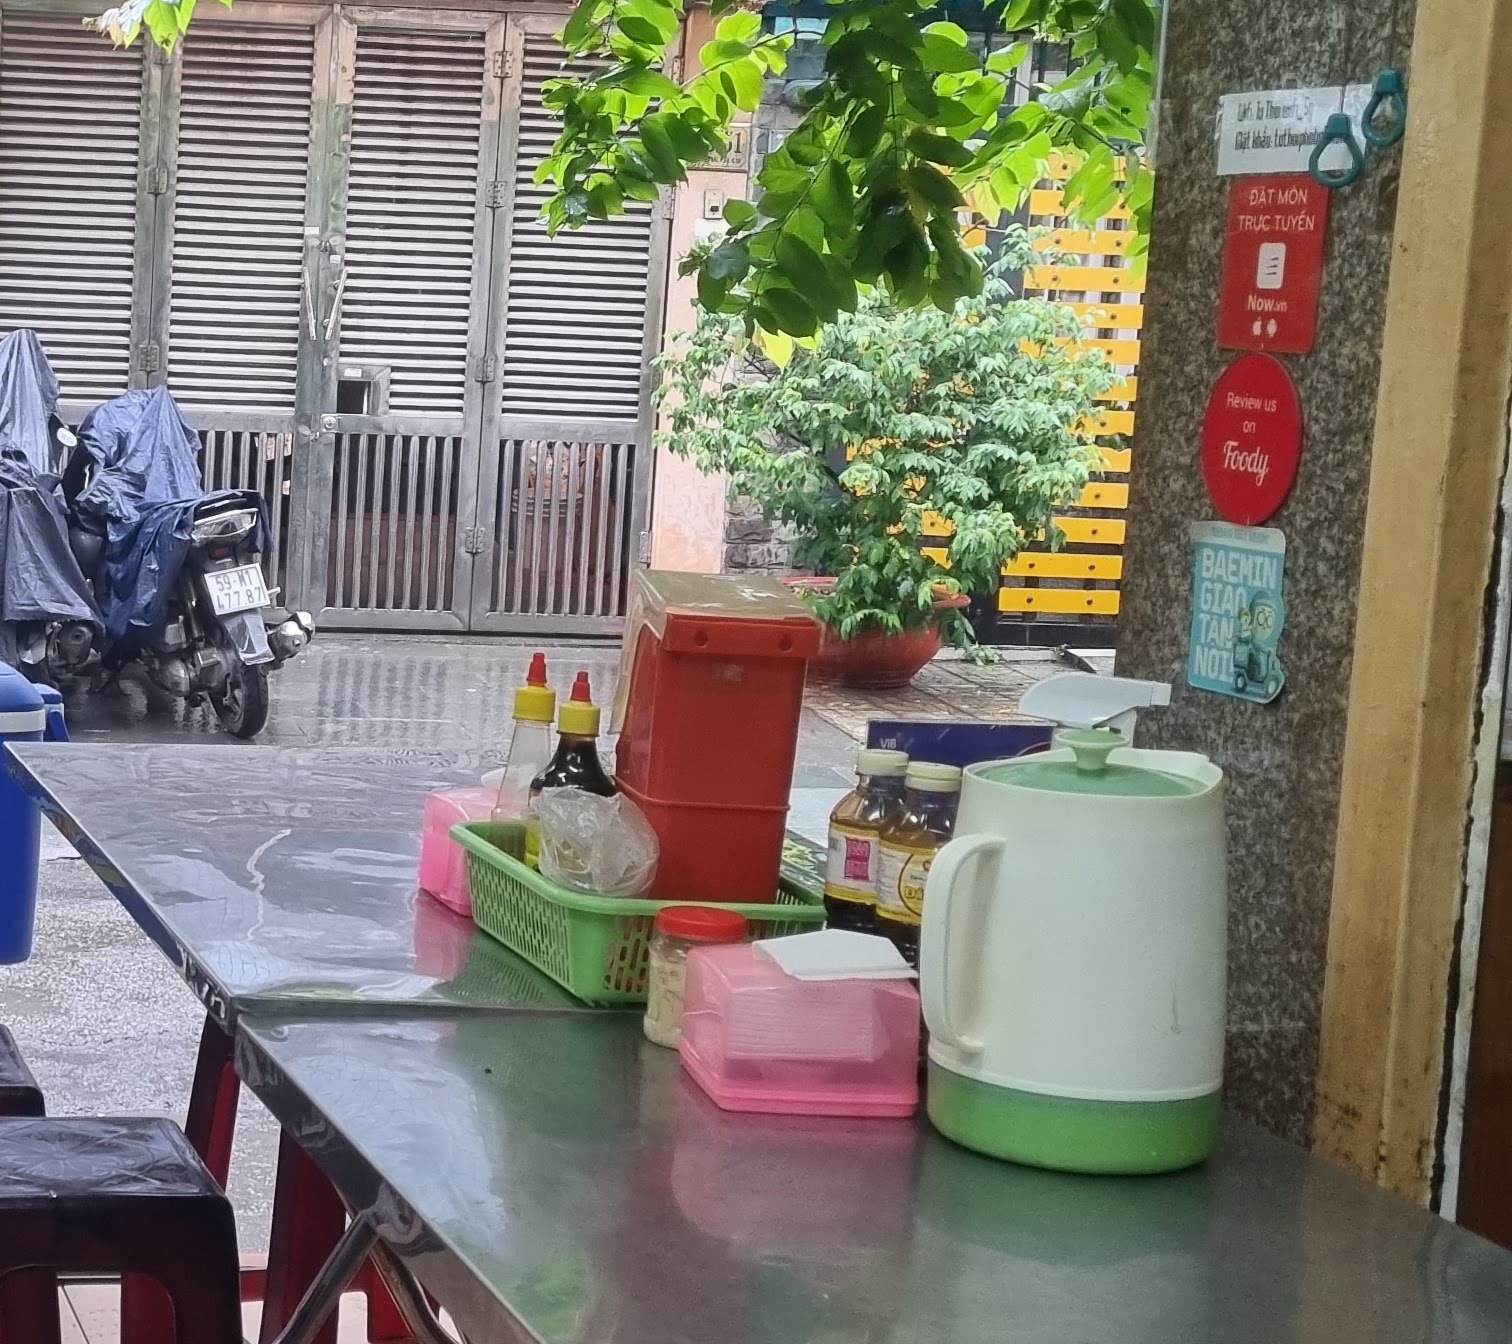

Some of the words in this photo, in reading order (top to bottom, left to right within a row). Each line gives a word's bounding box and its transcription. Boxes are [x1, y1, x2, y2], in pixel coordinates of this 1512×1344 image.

[1249, 185, 1275, 209] ĐẶT
[1239, 214, 1271, 235] TRỰC
[1275, 208, 1316, 232] TUYẾN
[1247, 294, 1288, 313] Now.vn
[1226, 391, 1262, 412] Review
[1264, 399, 1278, 413] us
[1243, 420, 1256, 434] on
[1223, 440, 1270, 487] Foody
[1201, 547, 1278, 589] BAEMIN
[1200, 580, 1248, 617] GIAO
